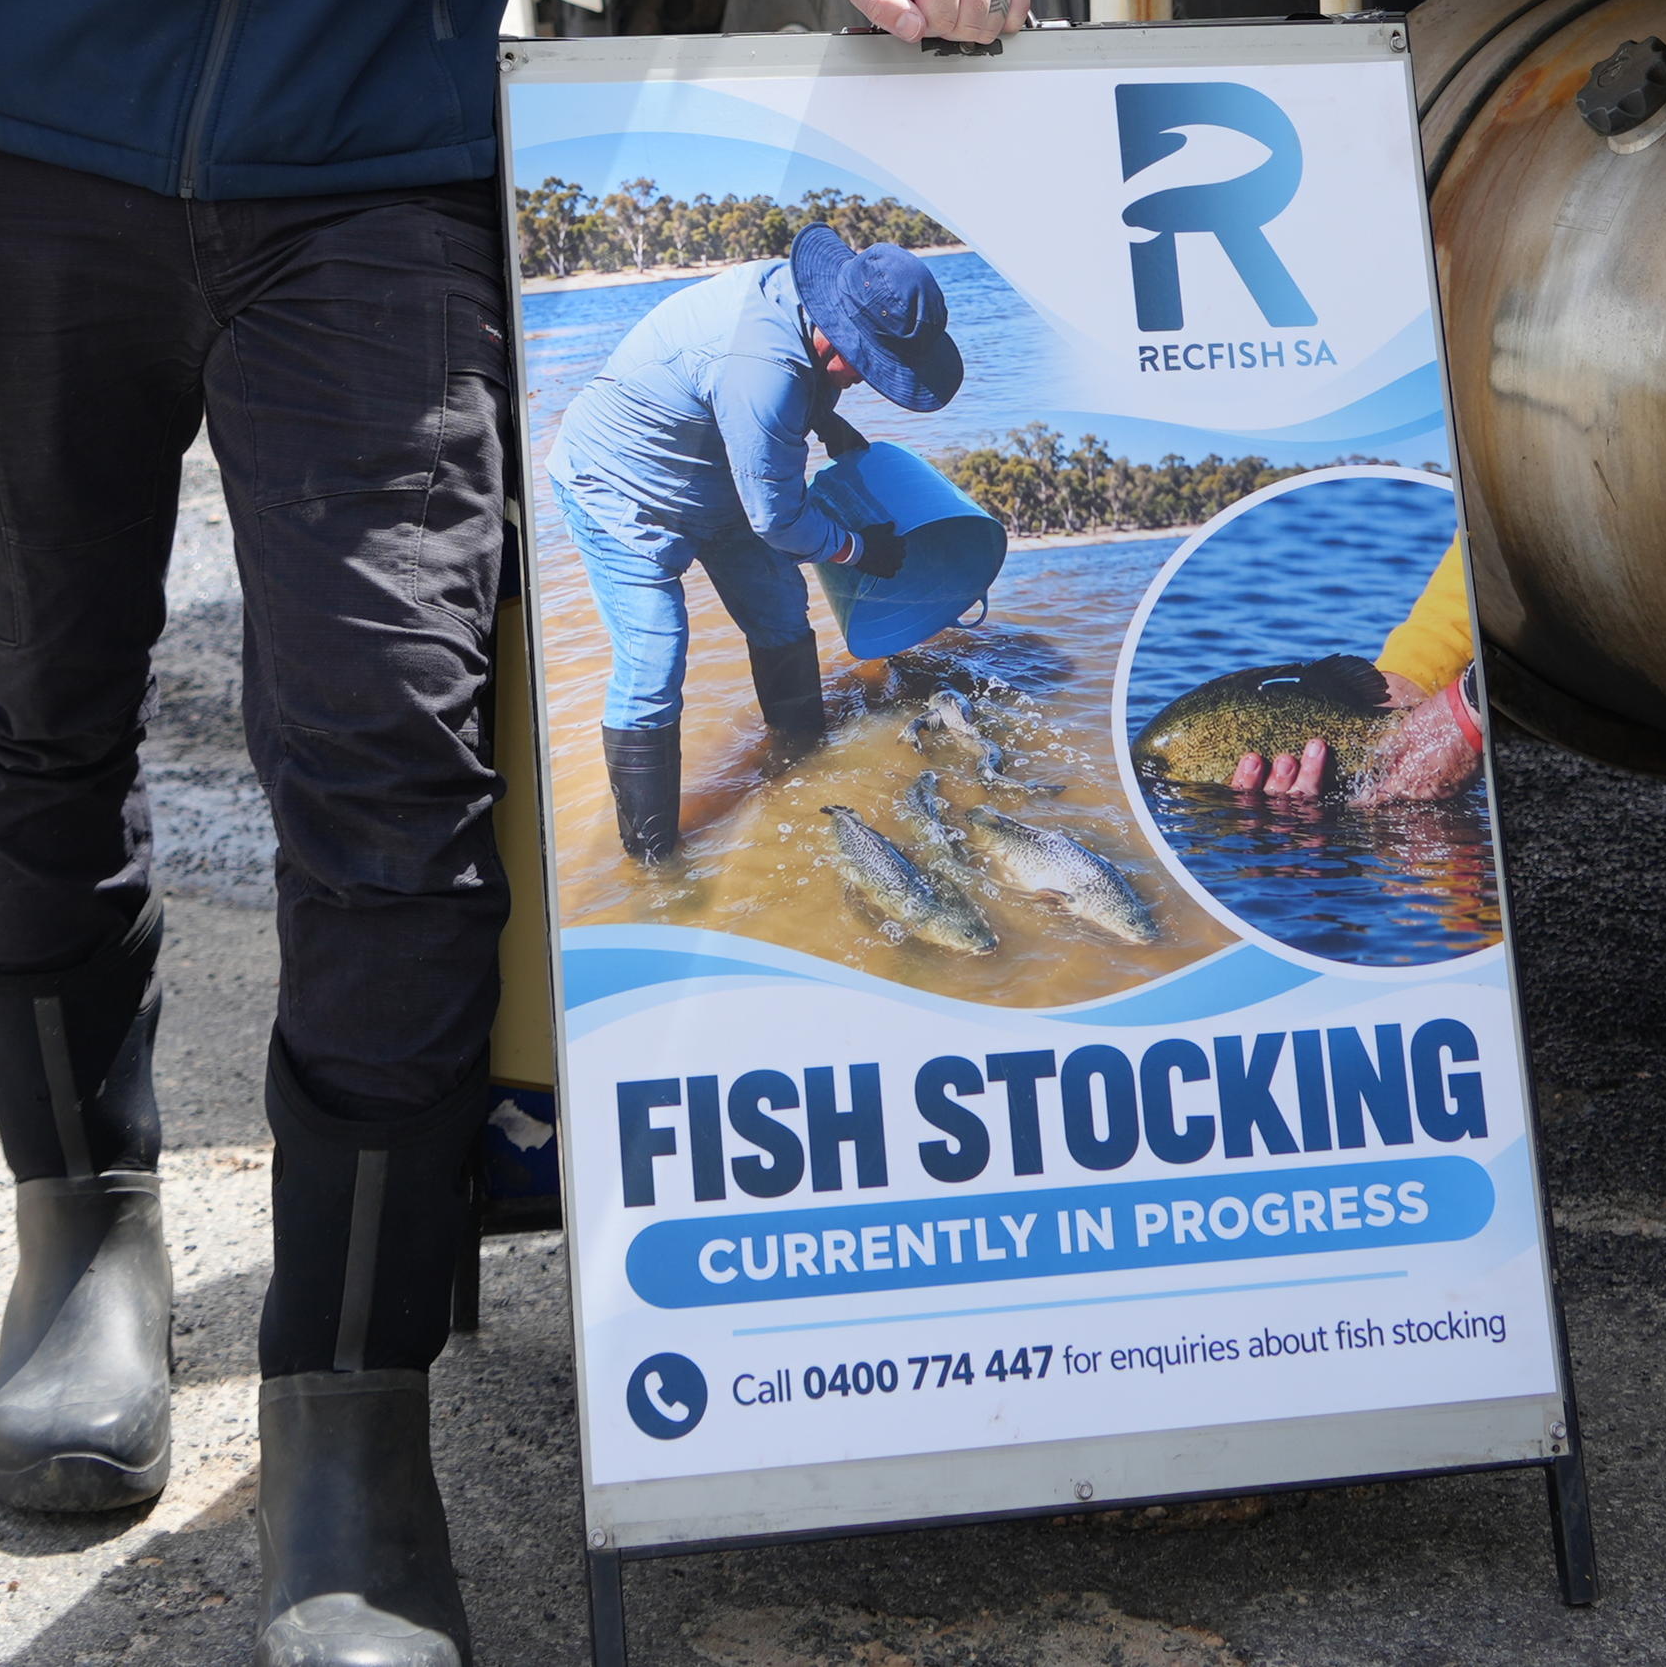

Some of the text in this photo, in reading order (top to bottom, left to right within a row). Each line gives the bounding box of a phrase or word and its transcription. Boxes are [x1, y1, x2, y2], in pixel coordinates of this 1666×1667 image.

[1138, 339, 1338, 372] RECFISH SA
[616, 1018, 1488, 1208] FISH STOCKING
[698, 1180, 1430, 1284] CURRENTLY IN PROGRESS
[733, 1310, 1507, 1406] Call 0400 774 447 for enquiries about fish stocking
